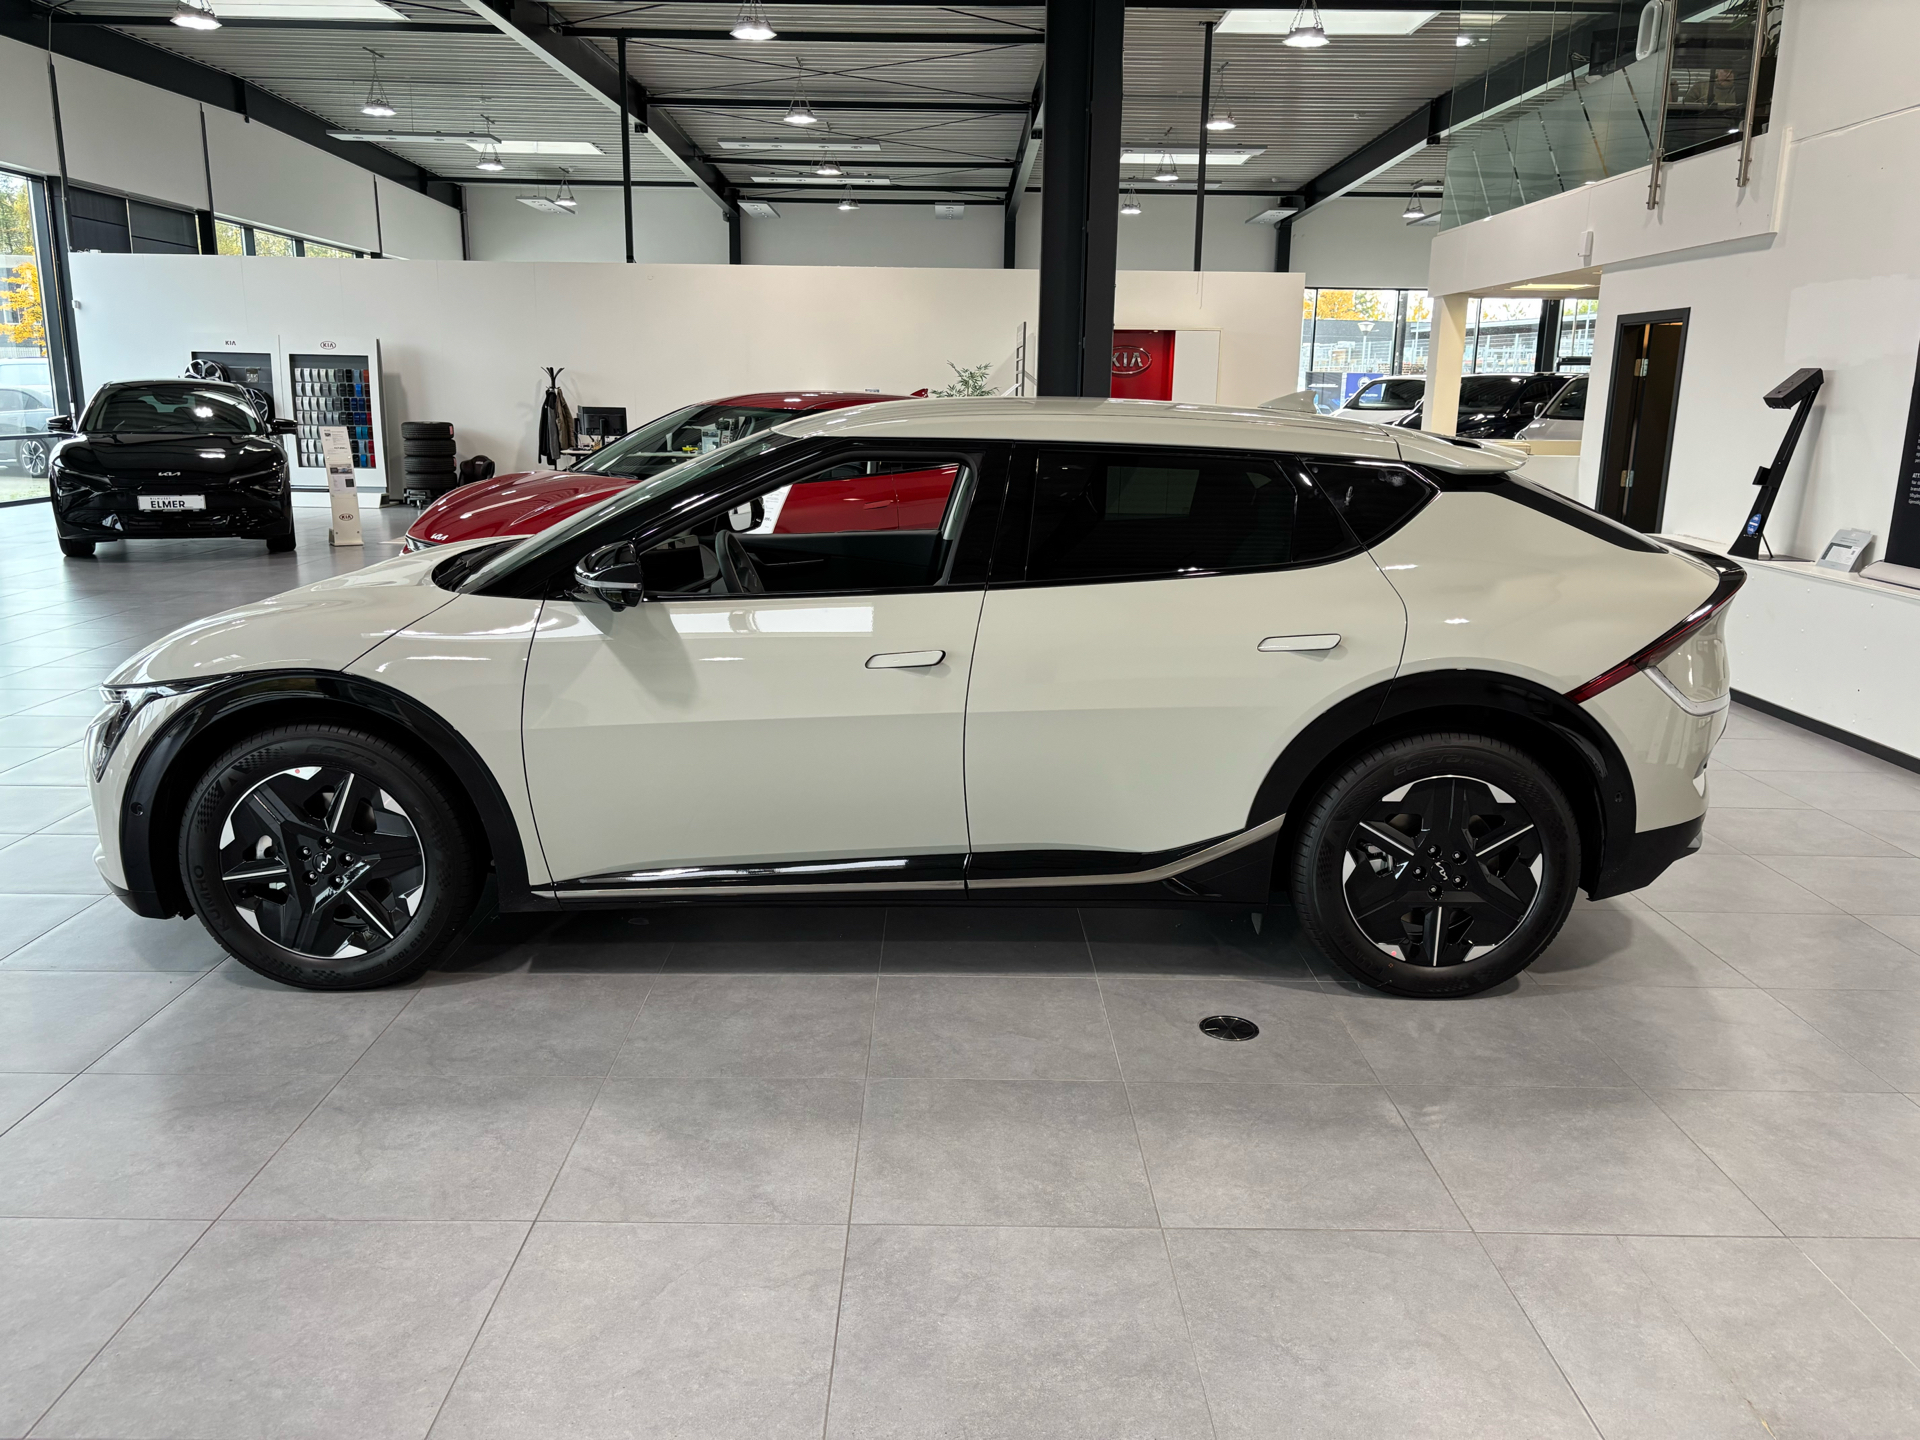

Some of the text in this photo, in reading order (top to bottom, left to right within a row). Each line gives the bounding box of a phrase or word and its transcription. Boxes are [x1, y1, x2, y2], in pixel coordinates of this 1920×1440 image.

[1111, 352, 1143, 367] KIA
[150, 500, 186, 509] ELMER
[193, 864, 230, 932] KUMHO
